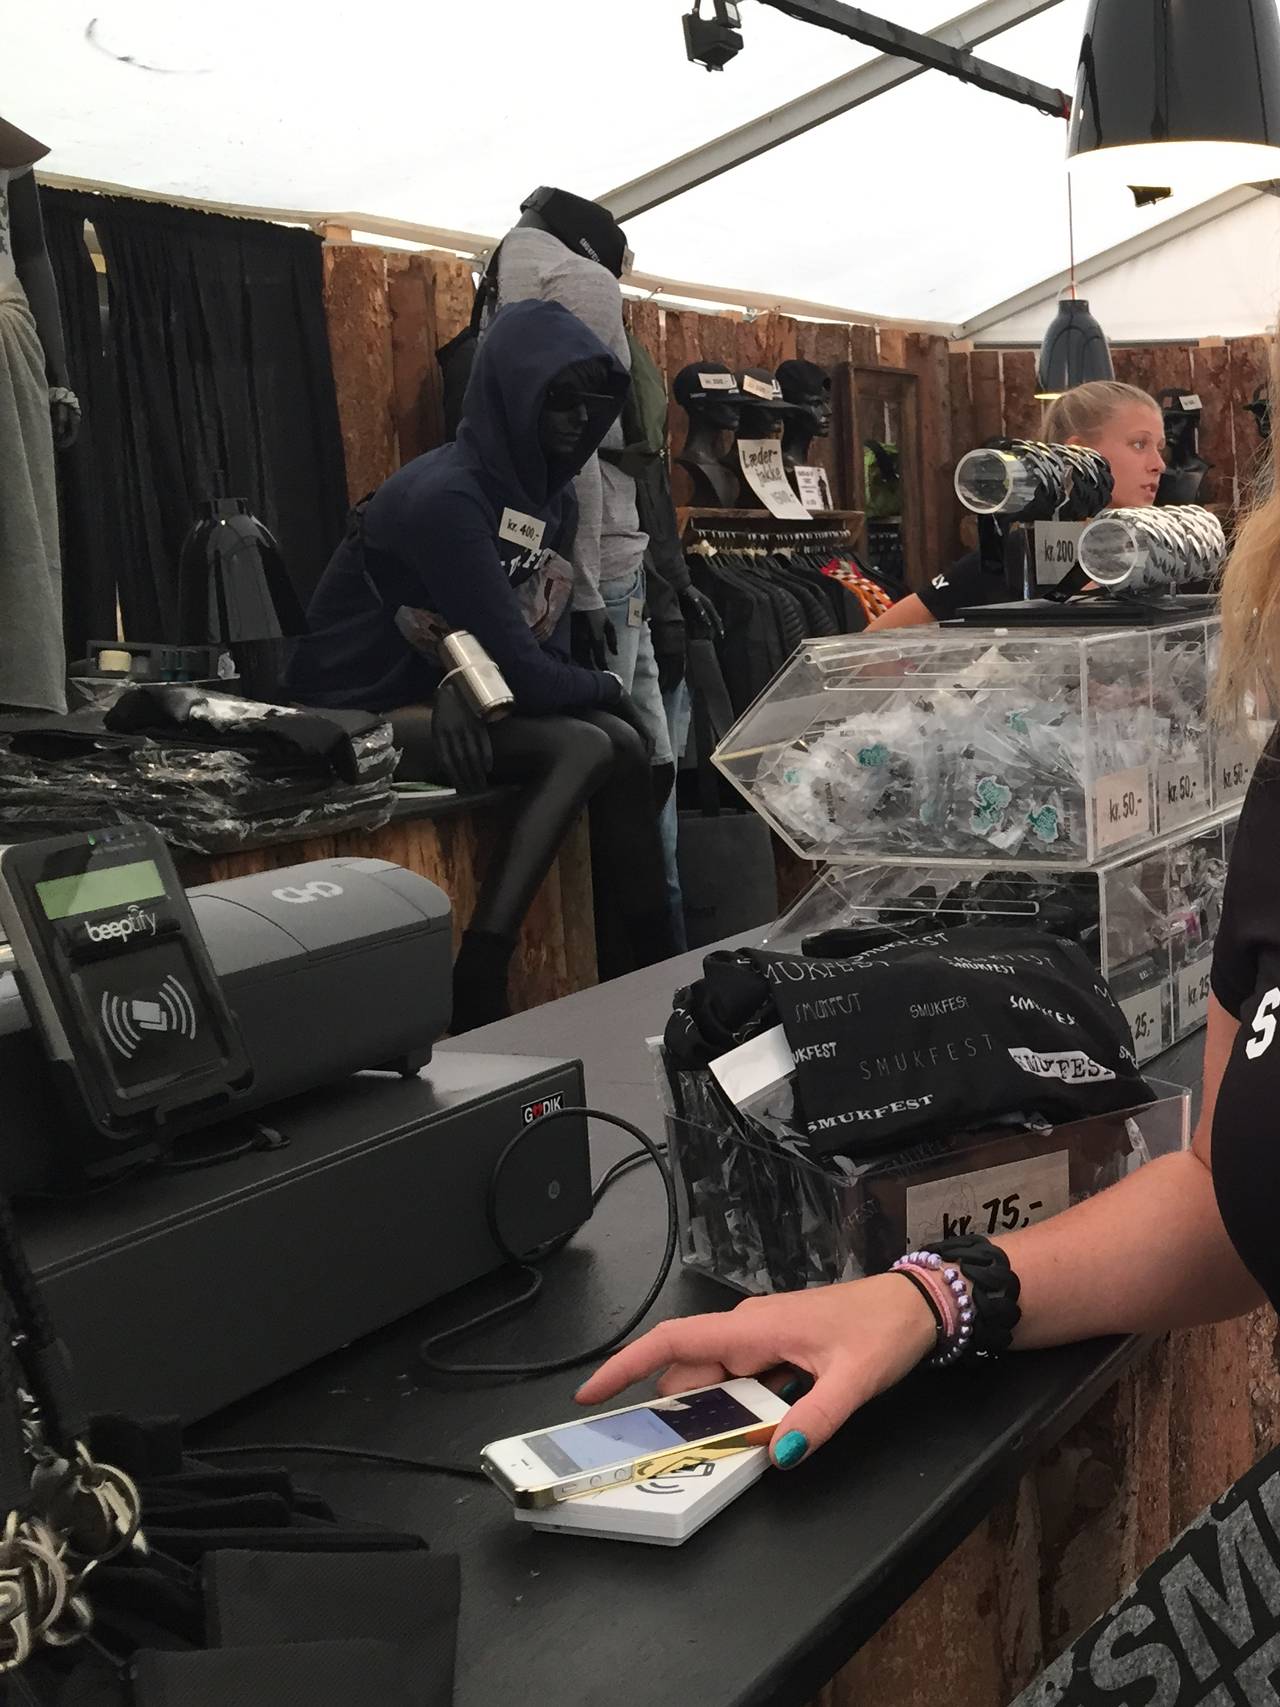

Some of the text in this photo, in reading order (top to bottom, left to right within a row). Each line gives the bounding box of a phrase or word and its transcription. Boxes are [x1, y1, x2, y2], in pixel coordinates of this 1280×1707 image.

[1044, 539, 1074, 562] kr. 200
[1168, 775, 1197, 804] kr. 50,-
[1109, 791, 1142, 823] kr. 50,-
[84, 908, 157, 943] beeptify
[1135, 1011, 1155, 1040] 25,-
[859, 1033, 992, 1081] SMUKFEST
[807, 1093, 933, 1133] SMUKFEST
[982, 1192, 1042, 1235] 75,-
